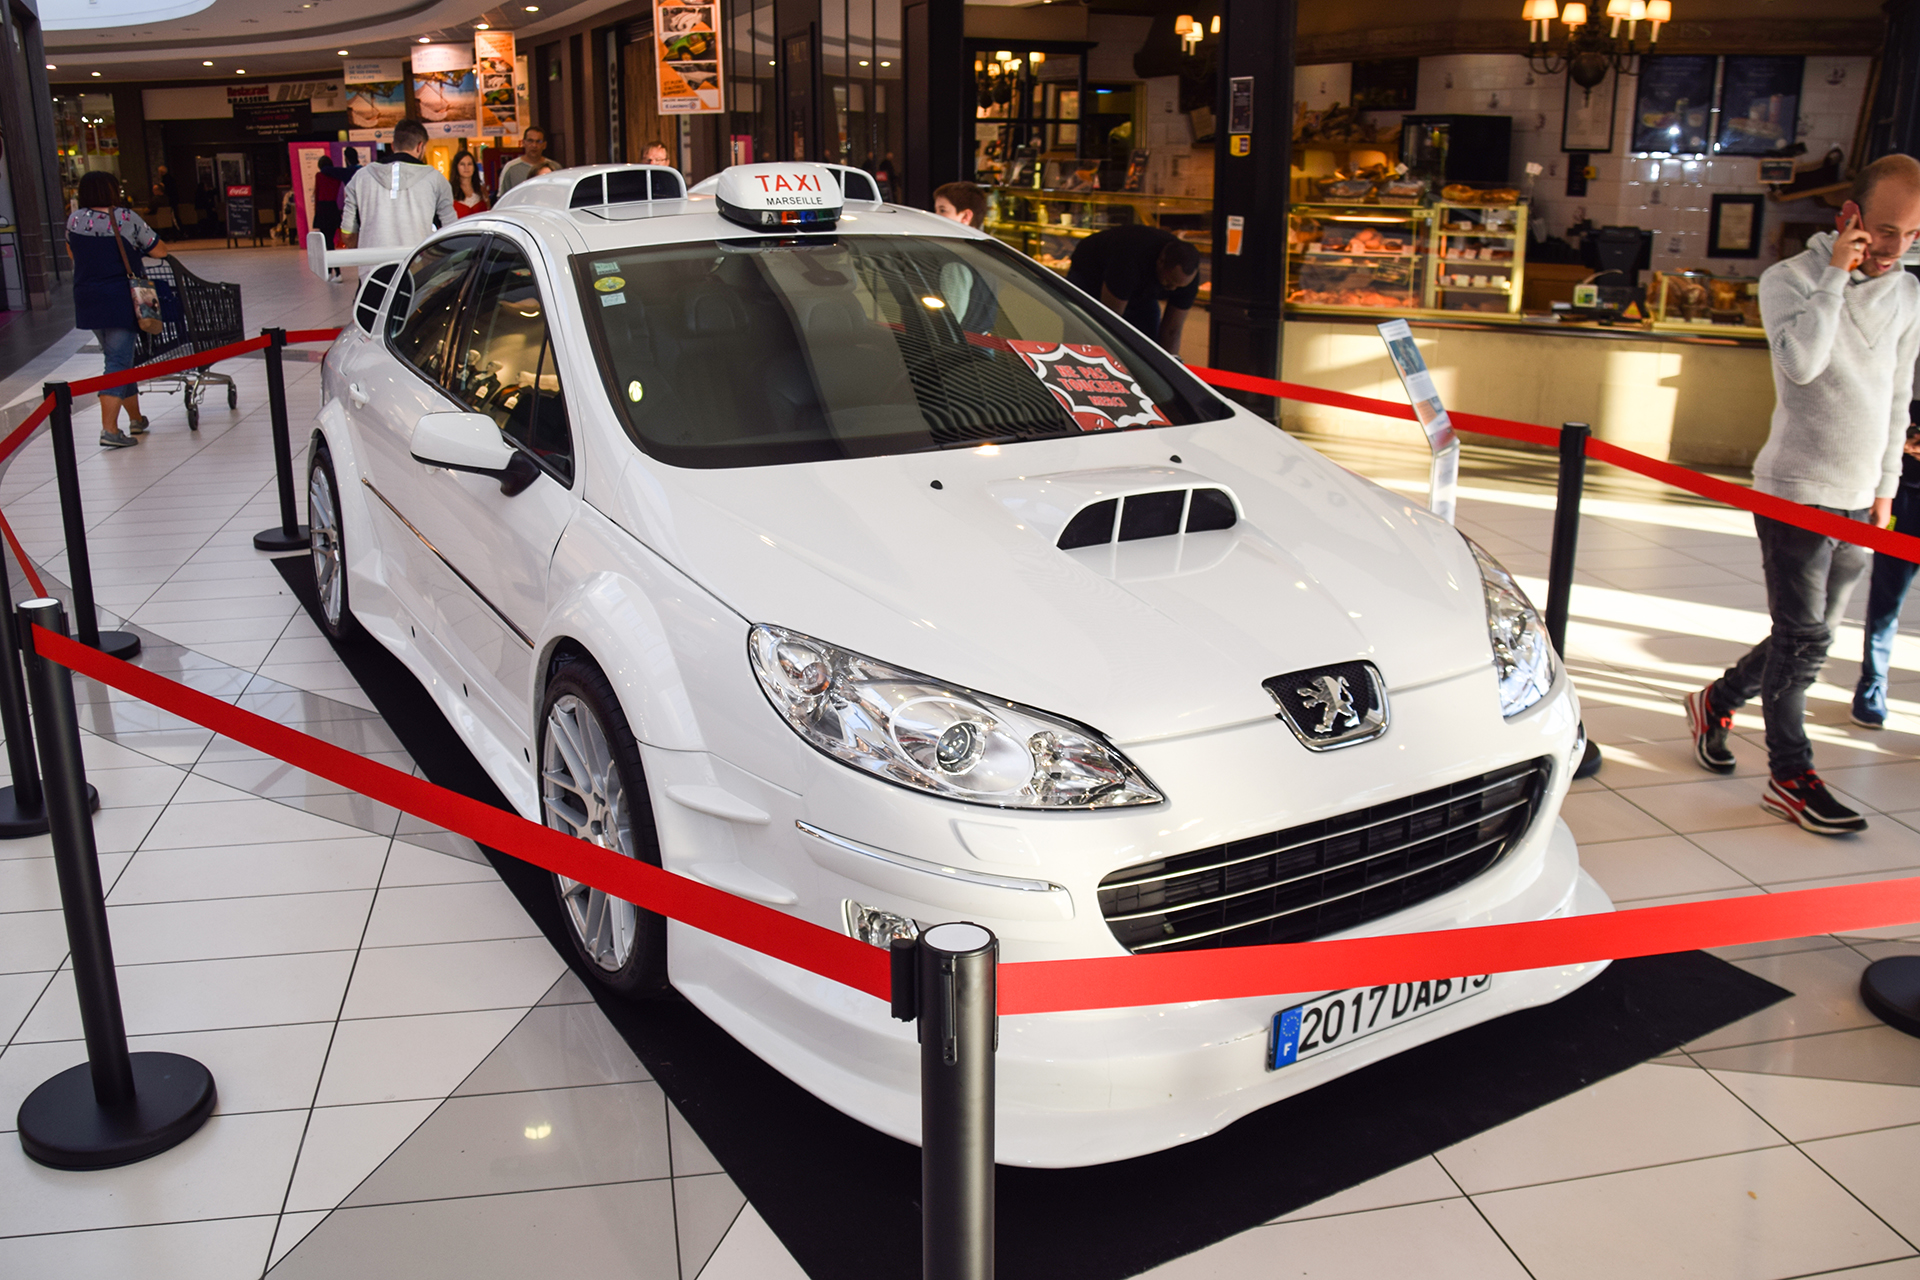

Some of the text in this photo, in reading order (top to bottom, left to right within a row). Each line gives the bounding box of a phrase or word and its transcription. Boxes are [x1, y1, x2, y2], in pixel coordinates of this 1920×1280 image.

[227, 85, 269, 97] Restaurant
[227, 96, 269, 104] BRASSERIE
[754, 174, 822, 193] TAXI
[766, 196, 823, 206] MARSEILLE
[766, 213, 775, 224] A
[1054, 364, 1109, 380] NE PAS
[1057, 378, 1130, 394] TOUCHER
[1088, 395, 1127, 407] MERCI
[1283, 1042, 1293, 1056] F
